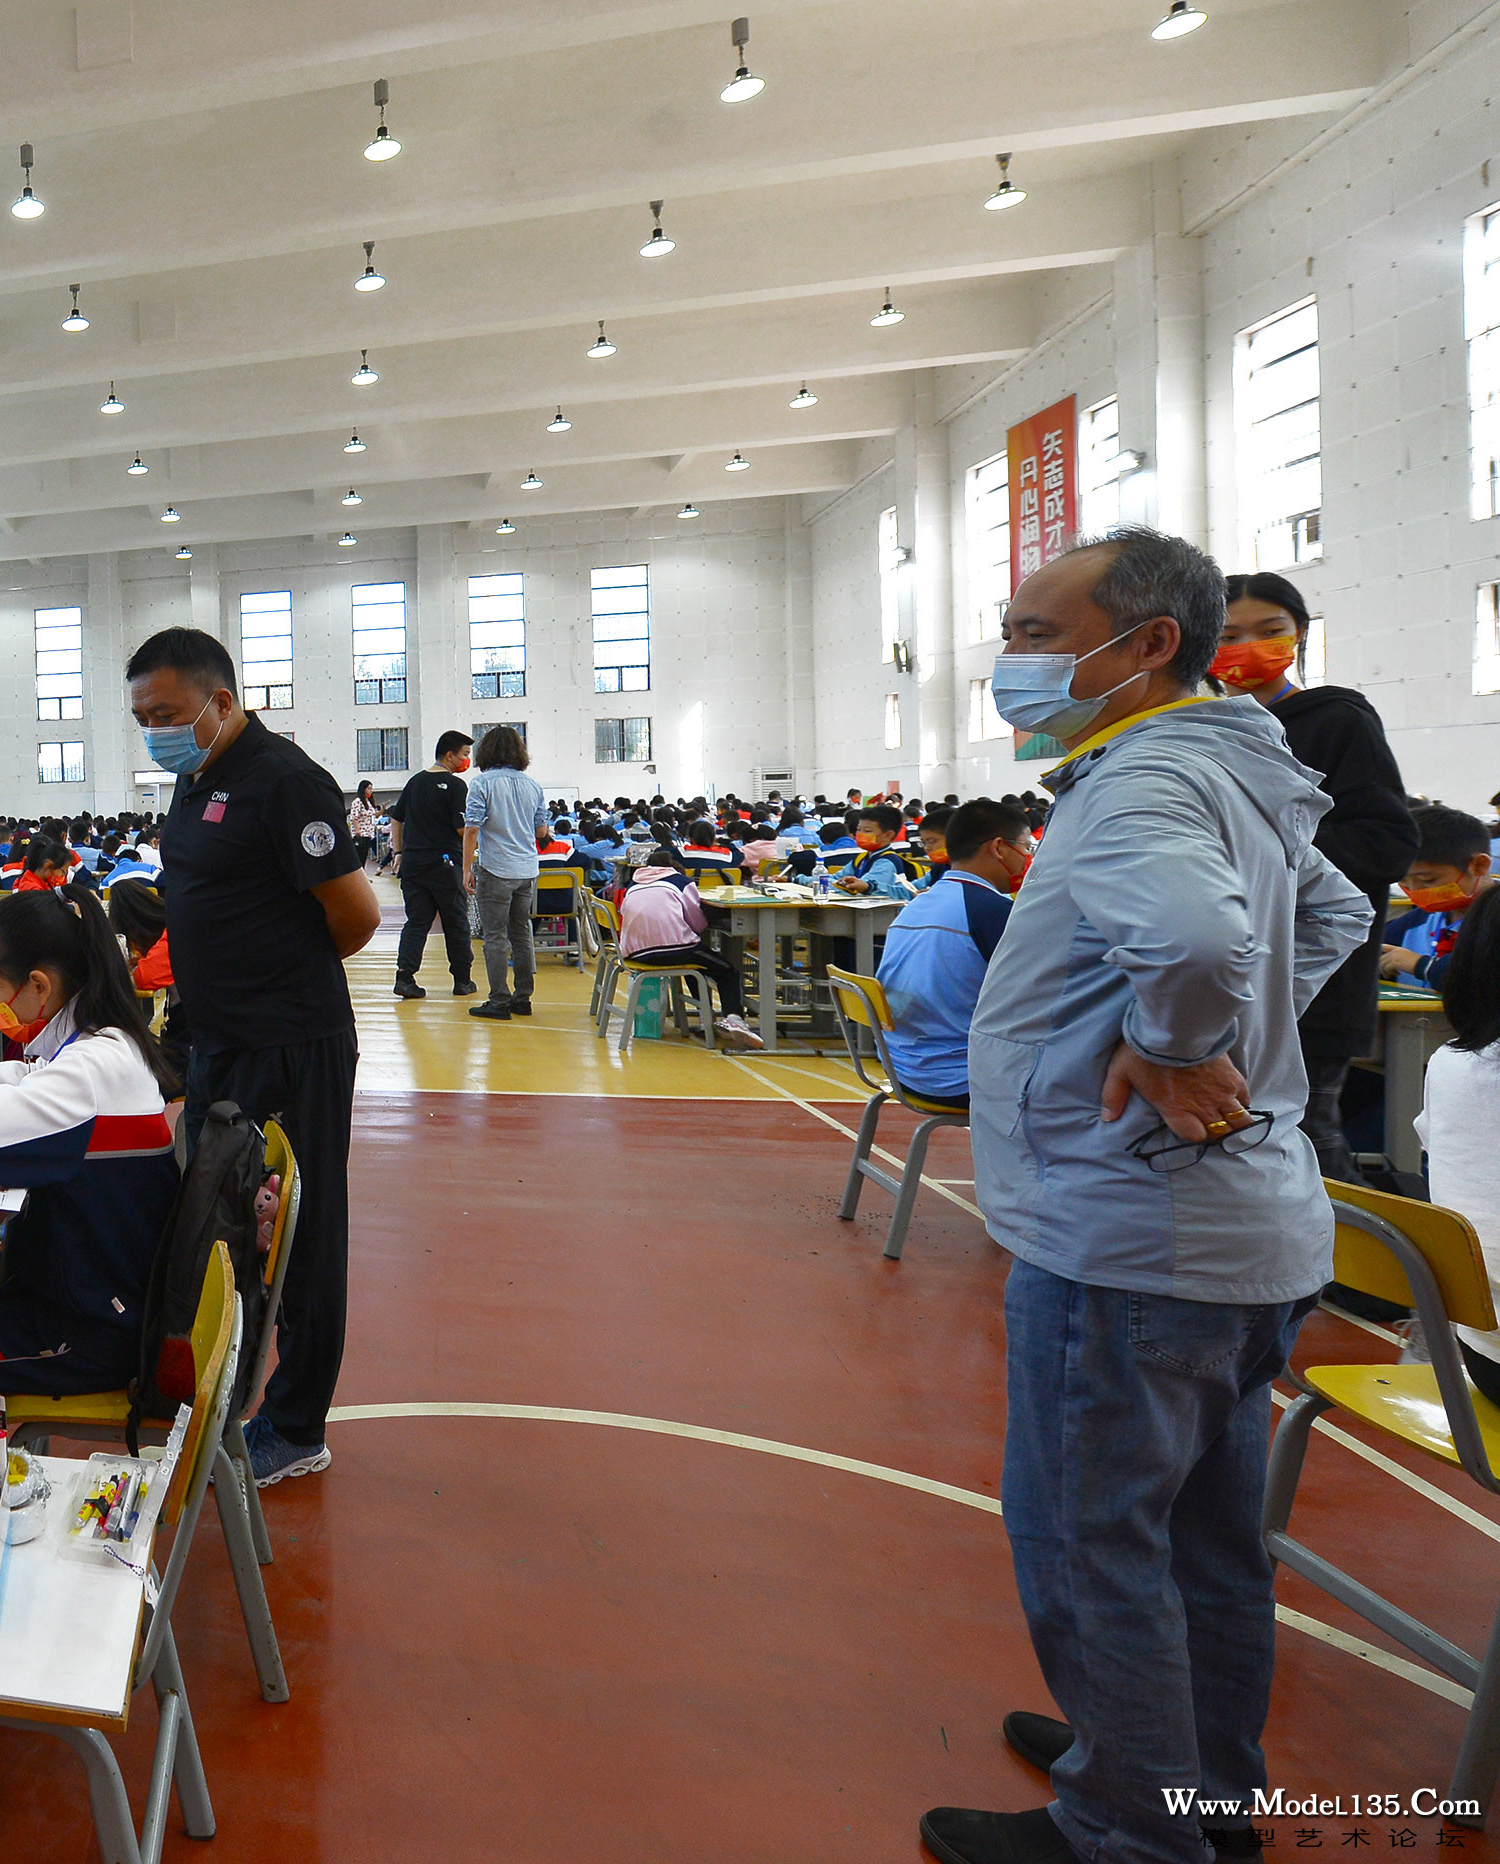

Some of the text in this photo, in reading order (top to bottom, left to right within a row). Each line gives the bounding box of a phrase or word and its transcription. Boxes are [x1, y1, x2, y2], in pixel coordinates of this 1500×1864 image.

[1042, 428, 1066, 563] 矢志成才
[211, 791, 230, 803] CHN
